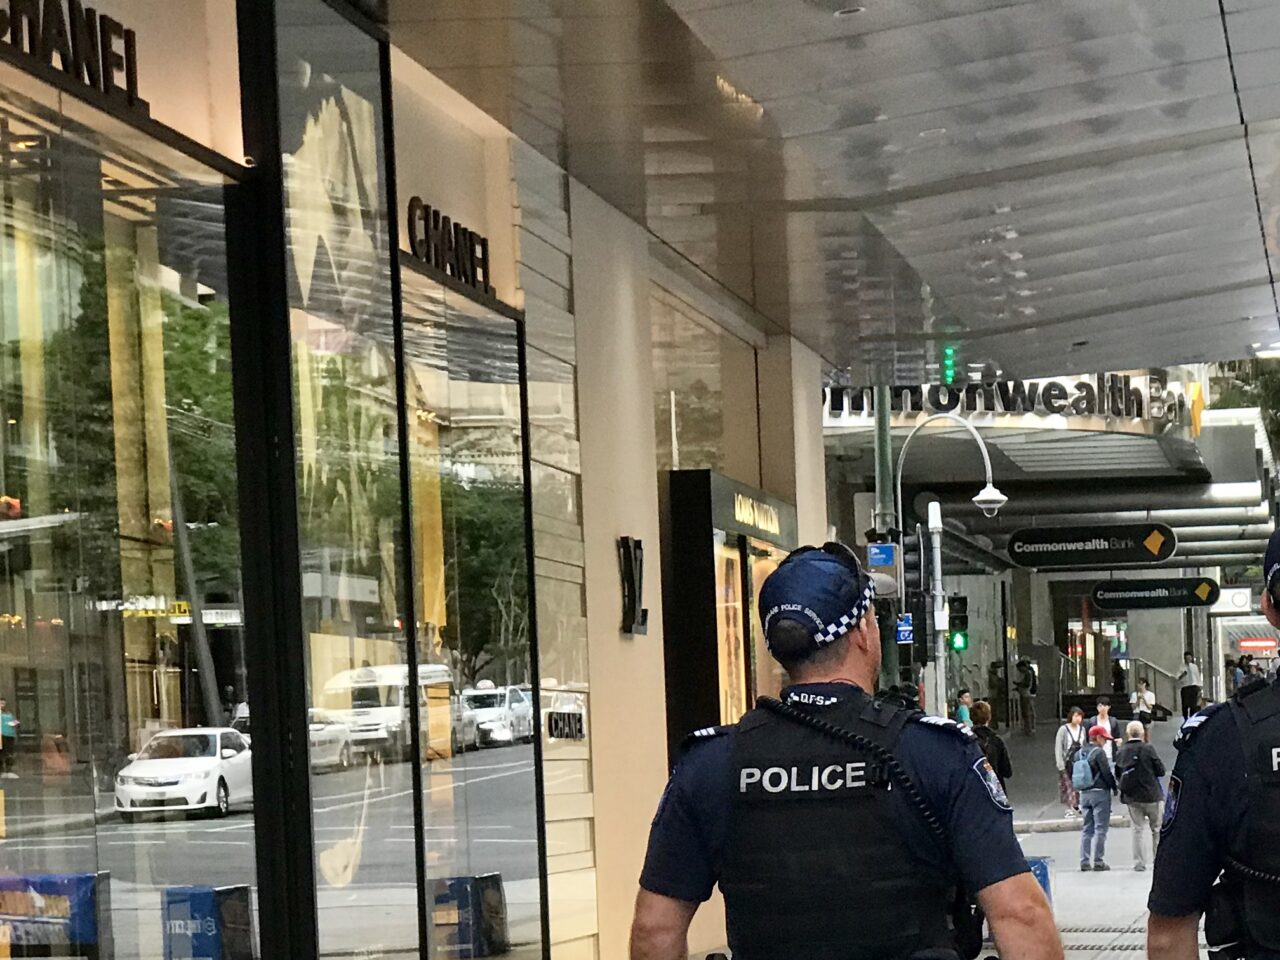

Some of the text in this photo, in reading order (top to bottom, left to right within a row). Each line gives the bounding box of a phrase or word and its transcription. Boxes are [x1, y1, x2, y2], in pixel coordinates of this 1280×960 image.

[408, 196, 496, 297] CHANEL
[1014, 537, 1135, 553] Commonwealth Bank
[1097, 588, 1169, 599] Commonwealth
[780, 603, 802, 612] POLICE
[739, 762, 866, 793] POLICE
